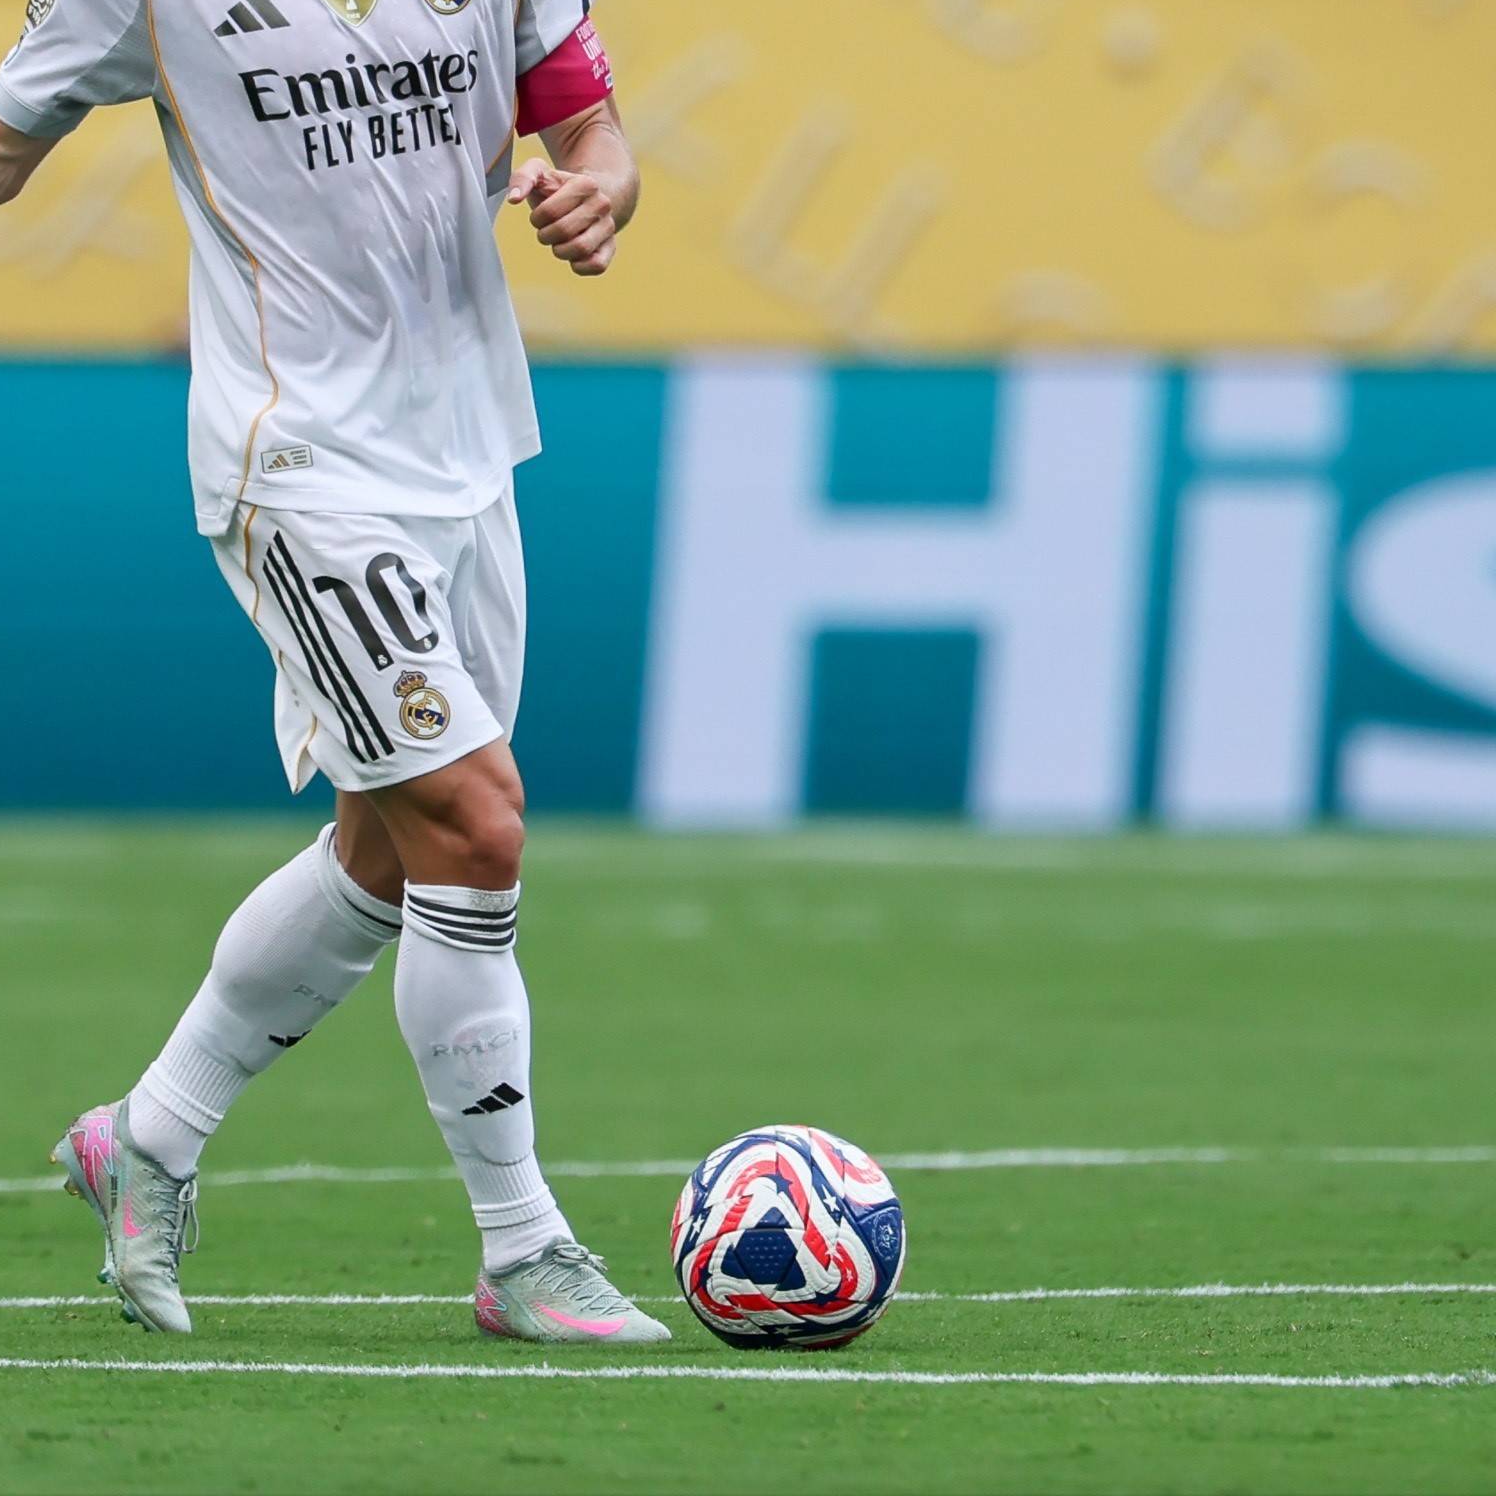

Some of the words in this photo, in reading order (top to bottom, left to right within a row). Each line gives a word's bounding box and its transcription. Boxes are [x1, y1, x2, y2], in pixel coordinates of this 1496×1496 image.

[238, 48, 478, 122] Emirates
[303, 120, 355, 171] FLY
[312, 552, 439, 671] 10
